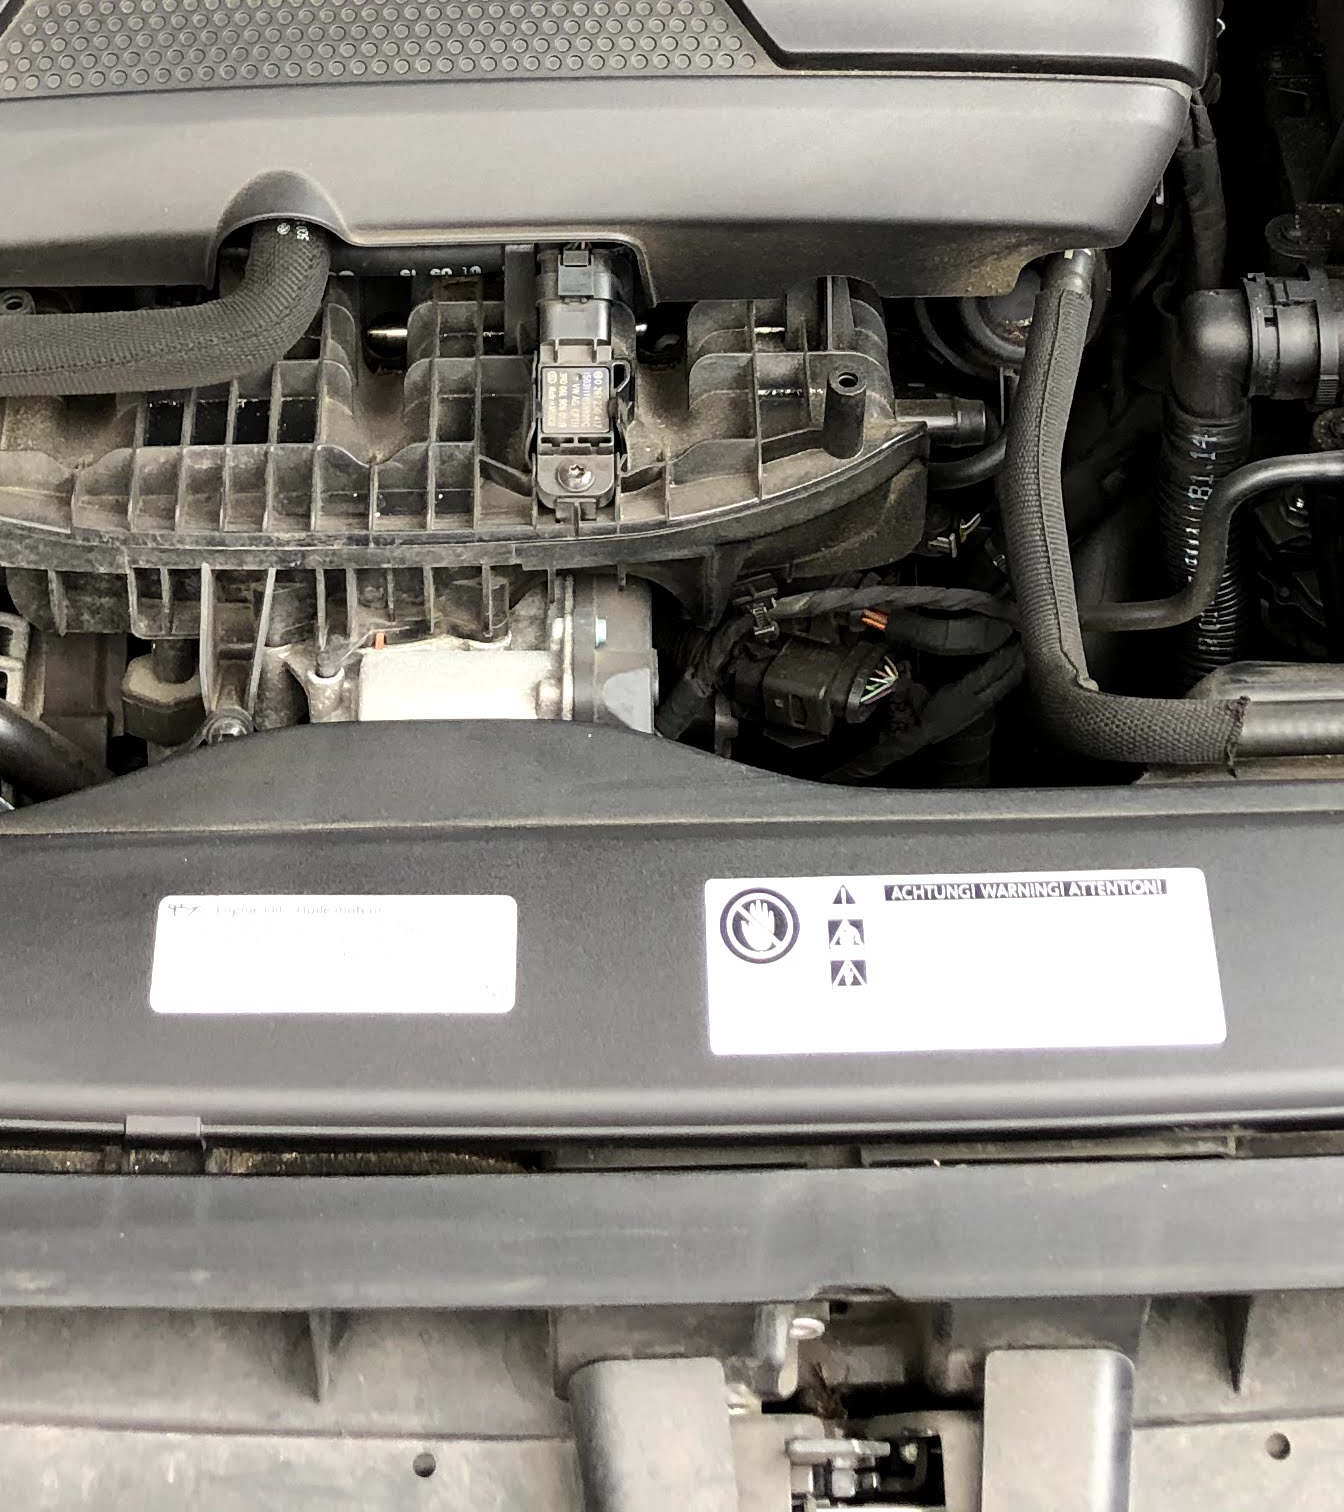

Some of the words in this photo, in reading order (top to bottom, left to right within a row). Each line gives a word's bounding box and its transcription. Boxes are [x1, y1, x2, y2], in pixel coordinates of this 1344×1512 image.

[890, 884, 974, 900] ACHTUNG!
[979, 882, 1063, 898] WARNING!
[1068, 879, 1163, 897] ATTENTION!
